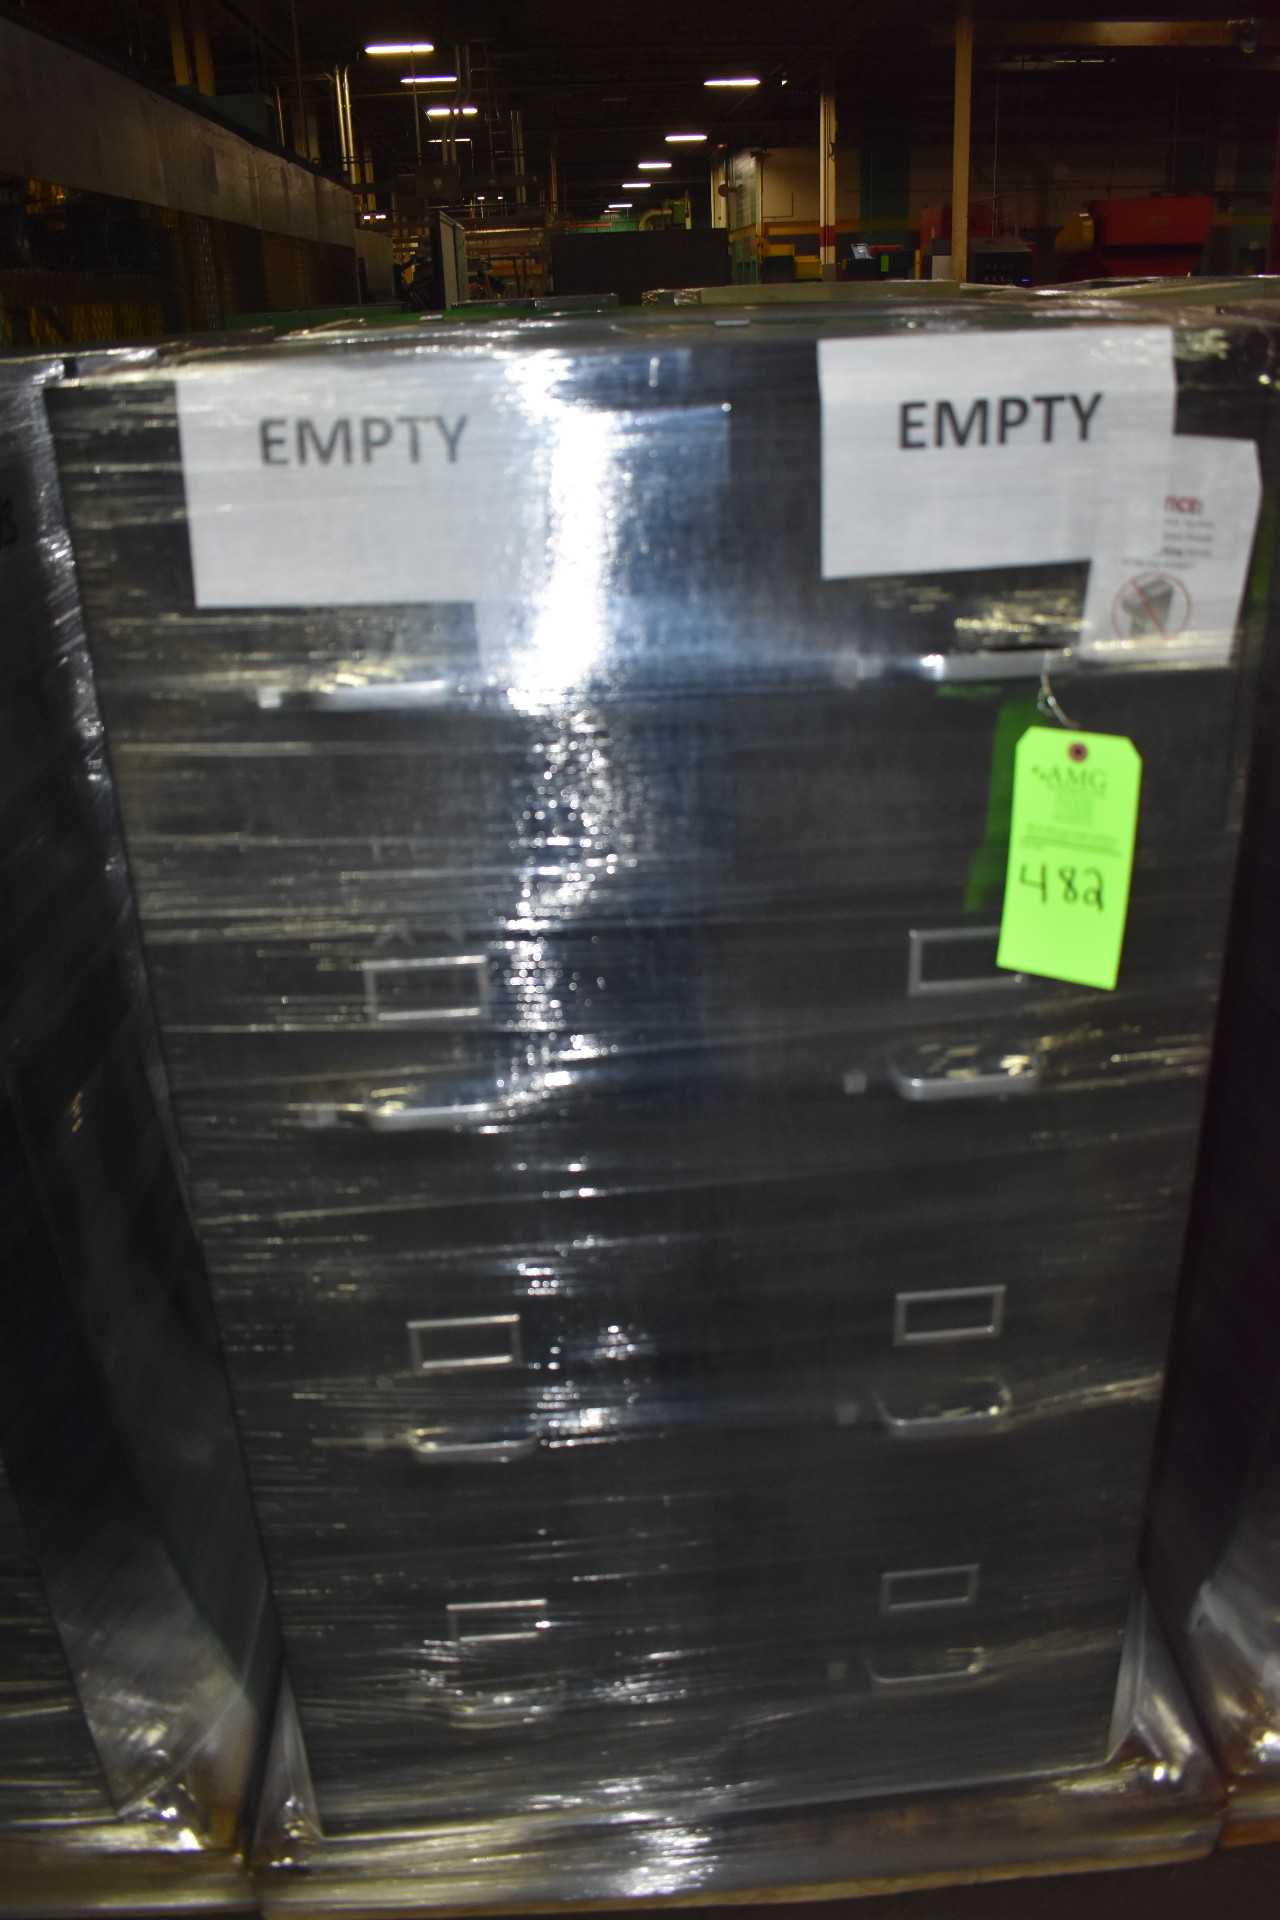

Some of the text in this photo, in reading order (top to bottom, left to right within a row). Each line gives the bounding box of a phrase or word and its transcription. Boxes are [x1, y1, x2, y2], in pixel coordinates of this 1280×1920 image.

[259, 414, 467, 466] EMPTY
[898, 391, 1103, 450] EMPTY
[1018, 862, 1105, 912] 482
